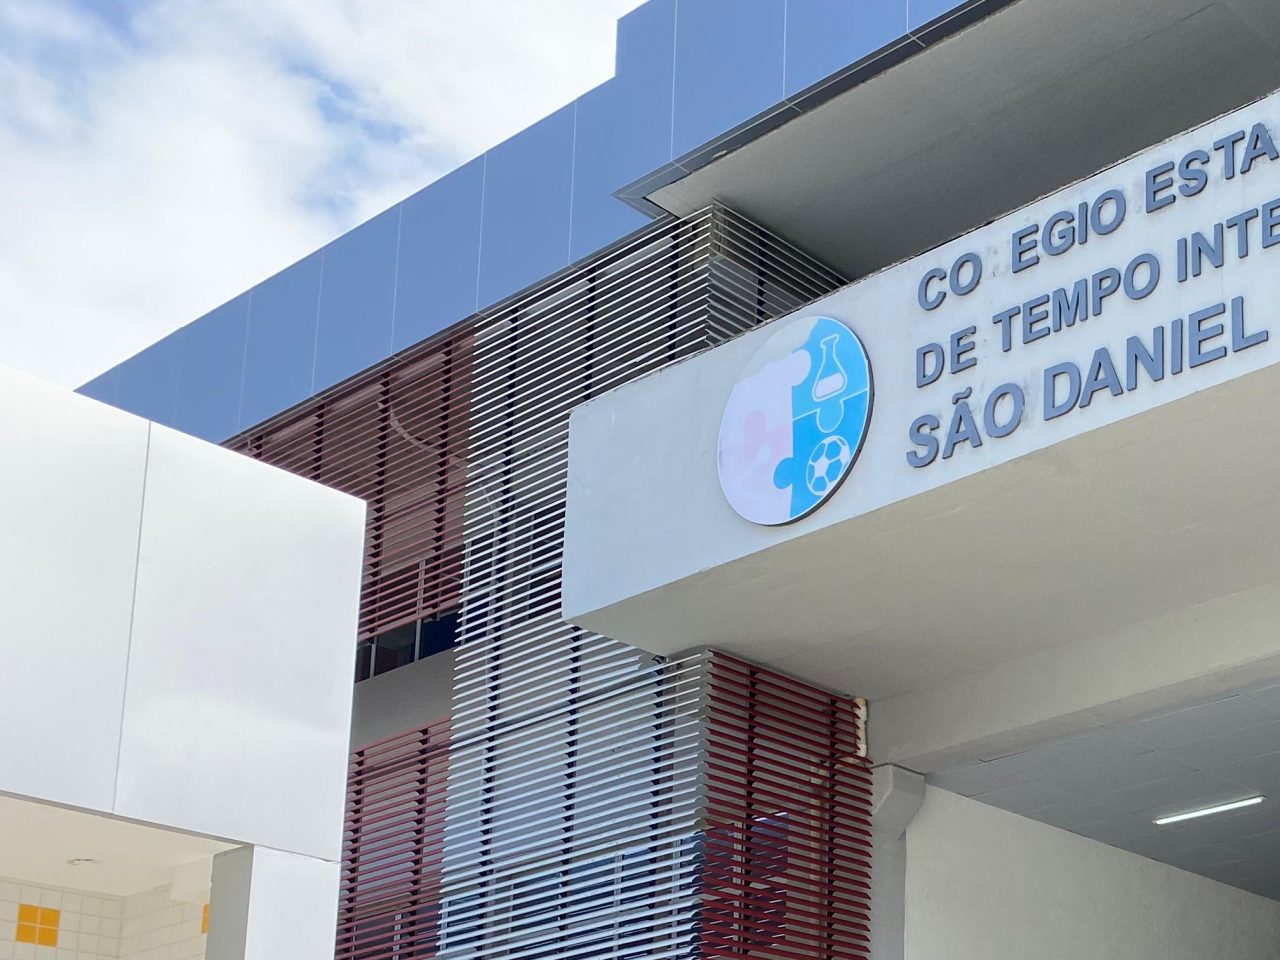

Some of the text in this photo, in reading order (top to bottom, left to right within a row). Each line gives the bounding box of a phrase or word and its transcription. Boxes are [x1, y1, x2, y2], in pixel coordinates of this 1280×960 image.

[906, 386, 1026, 468] SÃO
[1043, 295, 1269, 421] DANIEL
[915, 325, 978, 389] DE
[992, 252, 1161, 352] TEMPO
